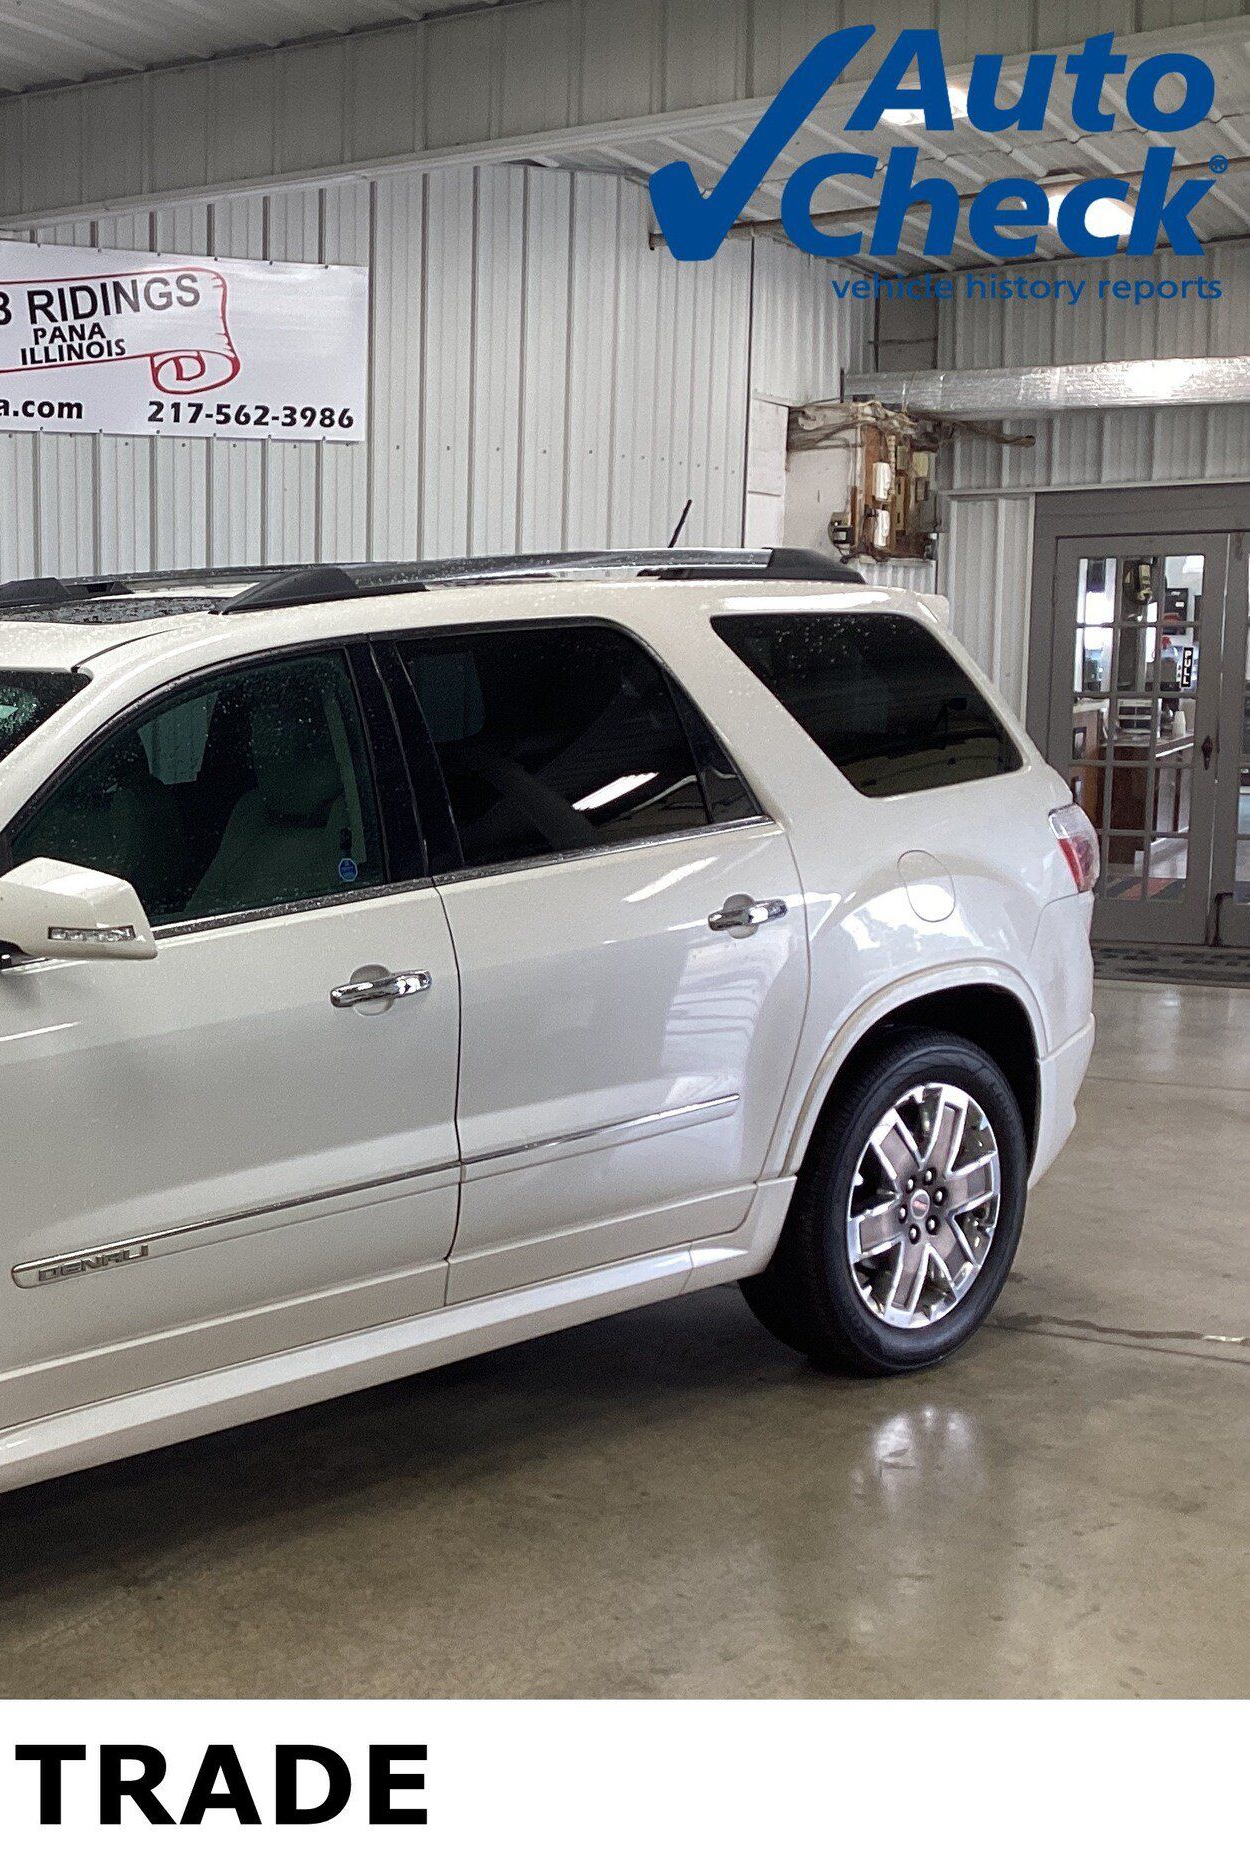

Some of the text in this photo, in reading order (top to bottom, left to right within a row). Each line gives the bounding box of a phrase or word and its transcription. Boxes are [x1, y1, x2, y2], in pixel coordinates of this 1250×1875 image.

[27, 272, 200, 326] RIDINGS
[33, 322, 106, 345] PANA
[20, 338, 126, 365] ILLINOIS
[147, 400, 354, 429] 217-562-3986
[1183, 650, 1192, 685] PULL
[38, 1244, 149, 1282] DENALI
